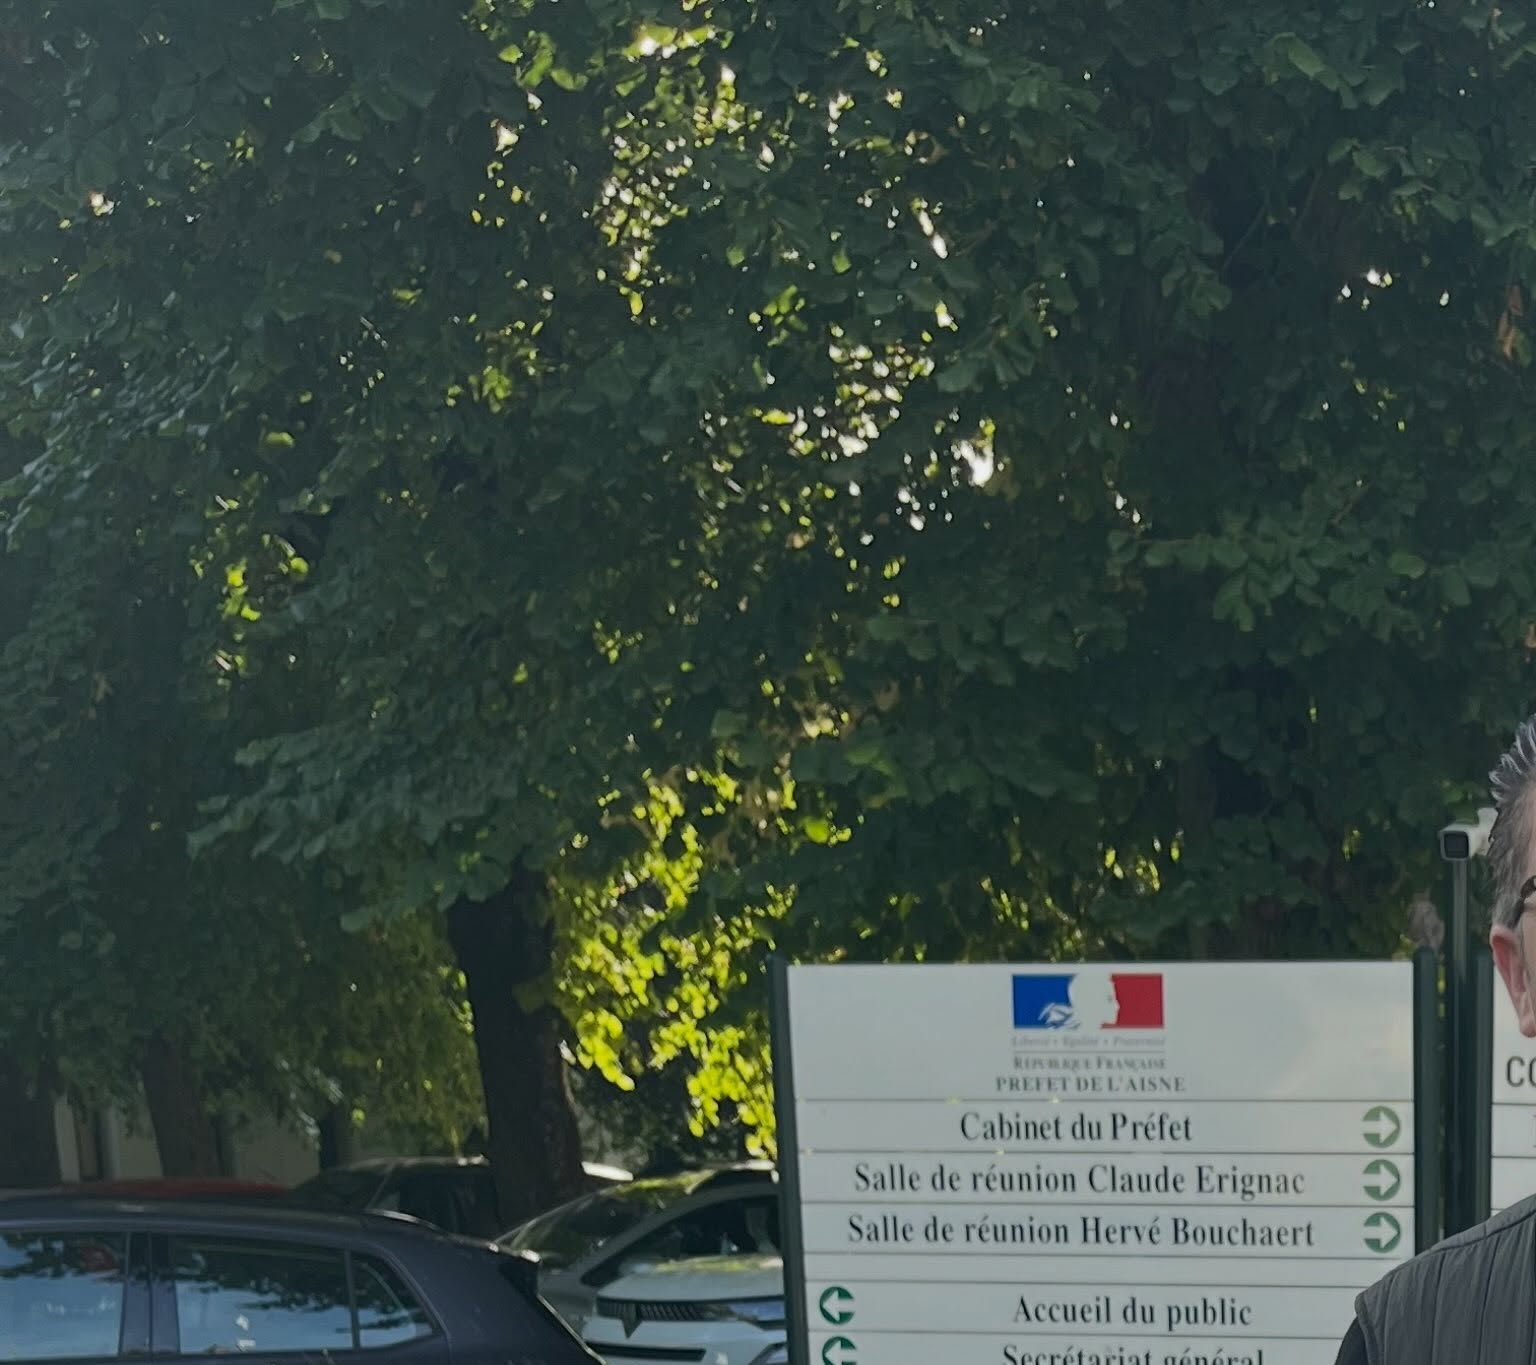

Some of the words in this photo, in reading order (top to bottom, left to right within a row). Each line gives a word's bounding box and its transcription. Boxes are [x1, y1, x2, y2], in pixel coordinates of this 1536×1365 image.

[1076, 1076, 1103, 1092] DE
[1108, 1076, 1187, 1092] L'AISNE
[961, 1111, 1061, 1141] Cabinet
[1071, 1112, 1101, 1141] du
[1111, 1112, 1192, 1141] Préfet
[855, 1163, 921, 1192] Salle
[931, 1164, 961, 1192] de
[972, 1164, 1076, 1192] réunion
[1088, 1164, 1185, 1193] Claude
[1196, 1165, 1305, 1201] Erignac
[848, 1214, 914, 1243] Salle
[924, 1215, 954, 1243] de
[965, 1215, 1068, 1244] réunion
[1080, 1216, 1161, 1245] Hervé
[1171, 1217, 1315, 1246] Bouchaert
[1013, 1295, 1112, 1323] Accueil
[1122, 1297, 1156, 1324] du
[1166, 1298, 1252, 1331] public
